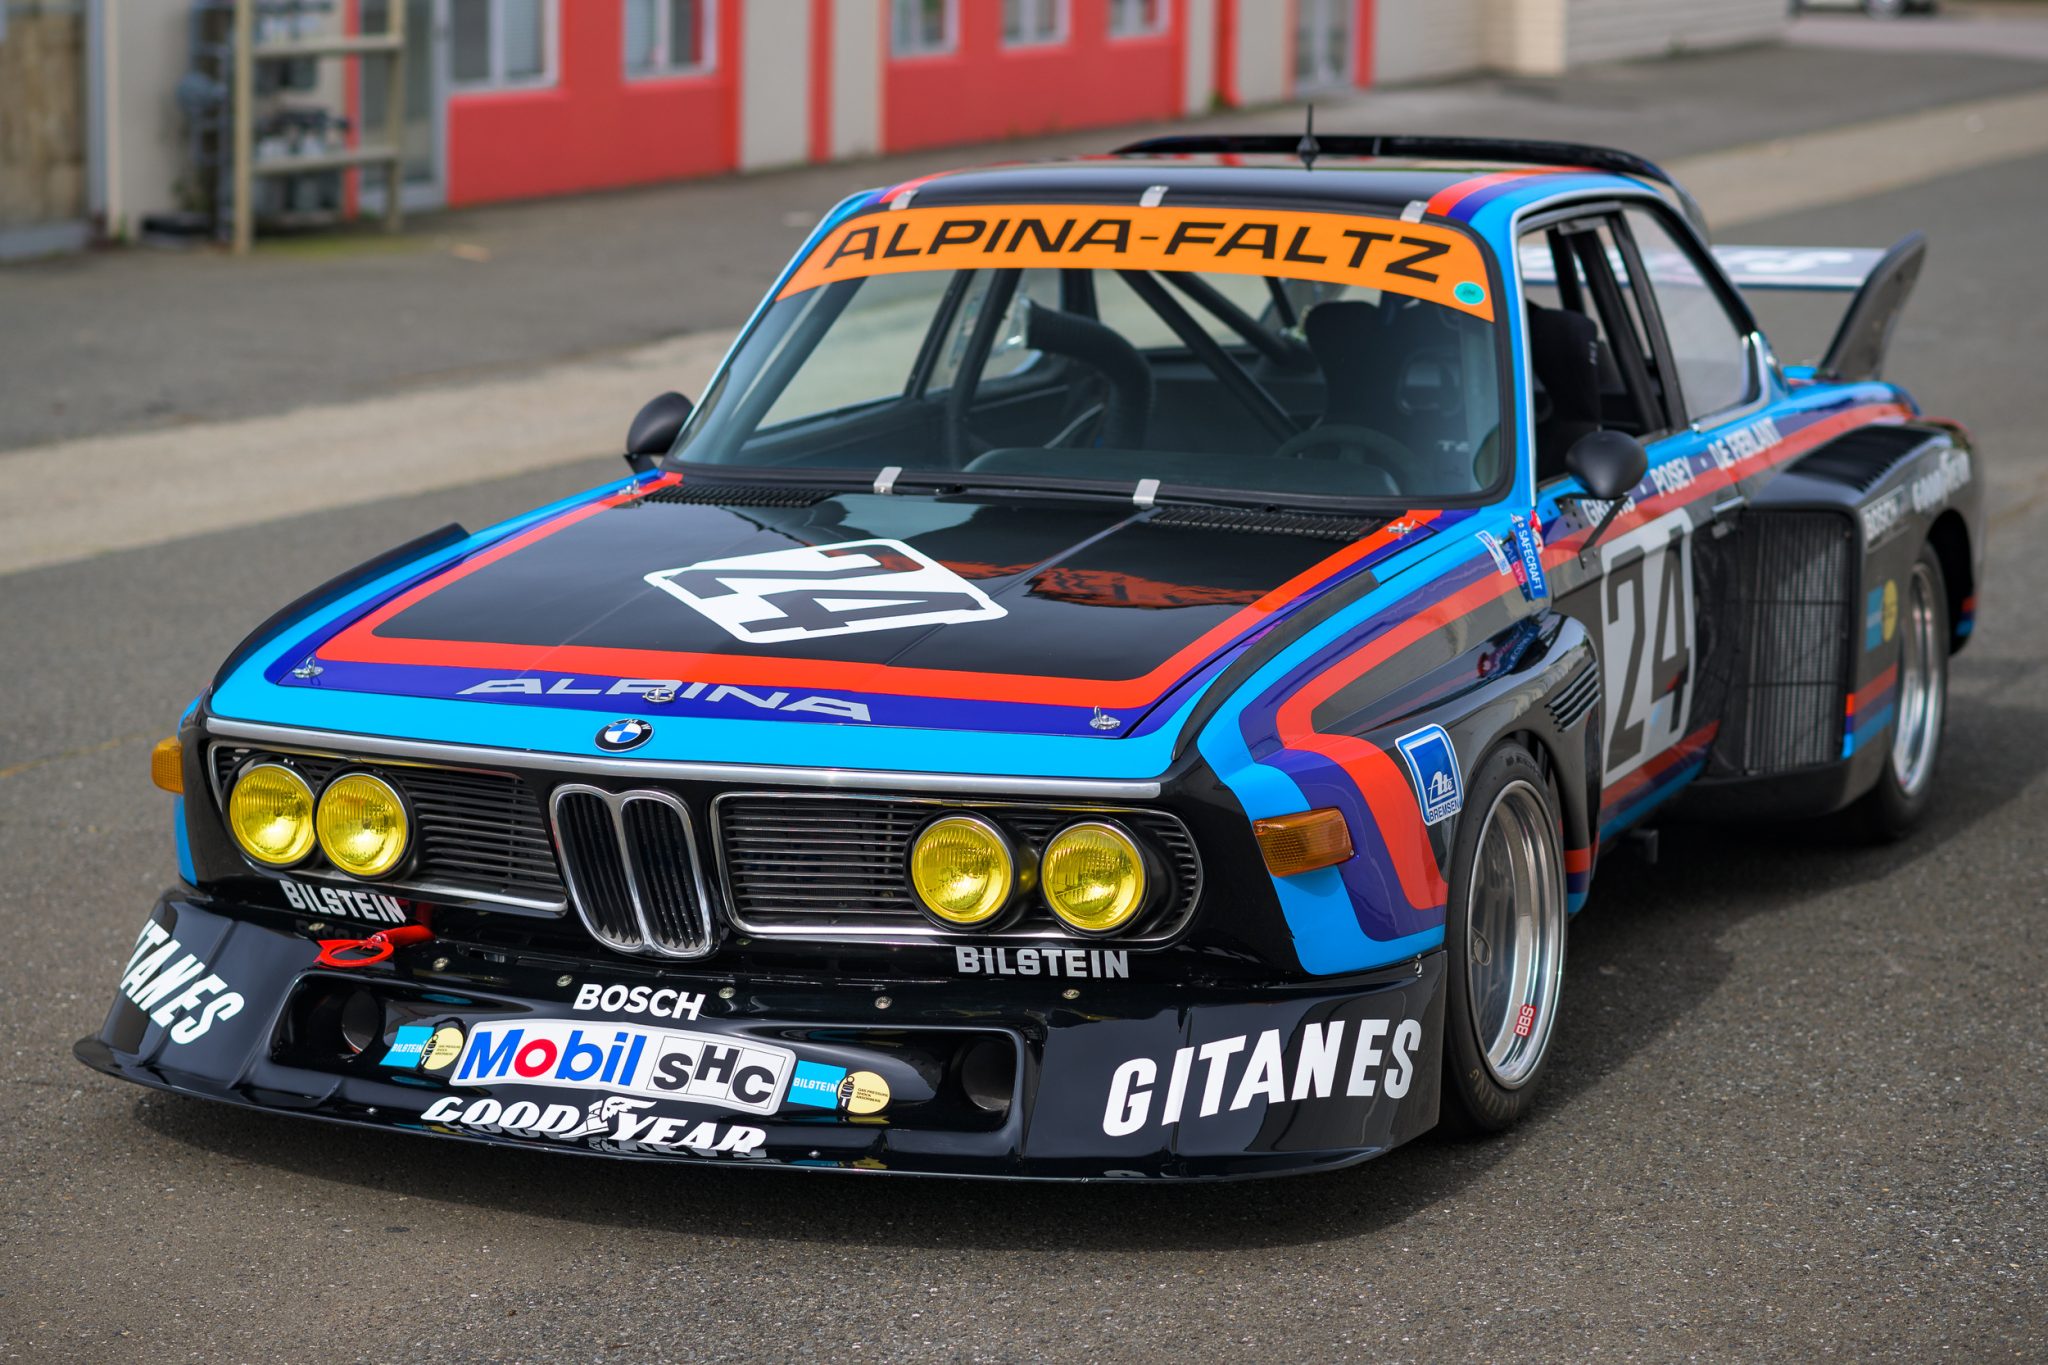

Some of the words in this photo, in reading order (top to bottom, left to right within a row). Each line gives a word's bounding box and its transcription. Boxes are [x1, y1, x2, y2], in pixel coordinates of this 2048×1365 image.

[824, 218, 1452, 283] ALPINA-FALTZ
[1649, 456, 1696, 497] POSEY
[1519, 530, 1543, 590] SAFECRAFT
[662, 544, 986, 634] 24
[1605, 522, 1690, 774] 24
[456, 677, 872, 722] ALPINA
[1429, 799, 1461, 822] BREMSEN
[279, 879, 407, 923] BILSTEIN
[955, 946, 1129, 978] BILSTEIN
[573, 983, 706, 1021] BOSCH
[1516, 1006, 1534, 1036] BBS
[391, 1043, 423, 1053] BILSTEIN
[457, 1028, 648, 1087] Mobil
[653, 1043, 775, 1104] SHC
[793, 1077, 838, 1092] BILSTEIN
[1103, 1019, 1421, 1137] GITANES
